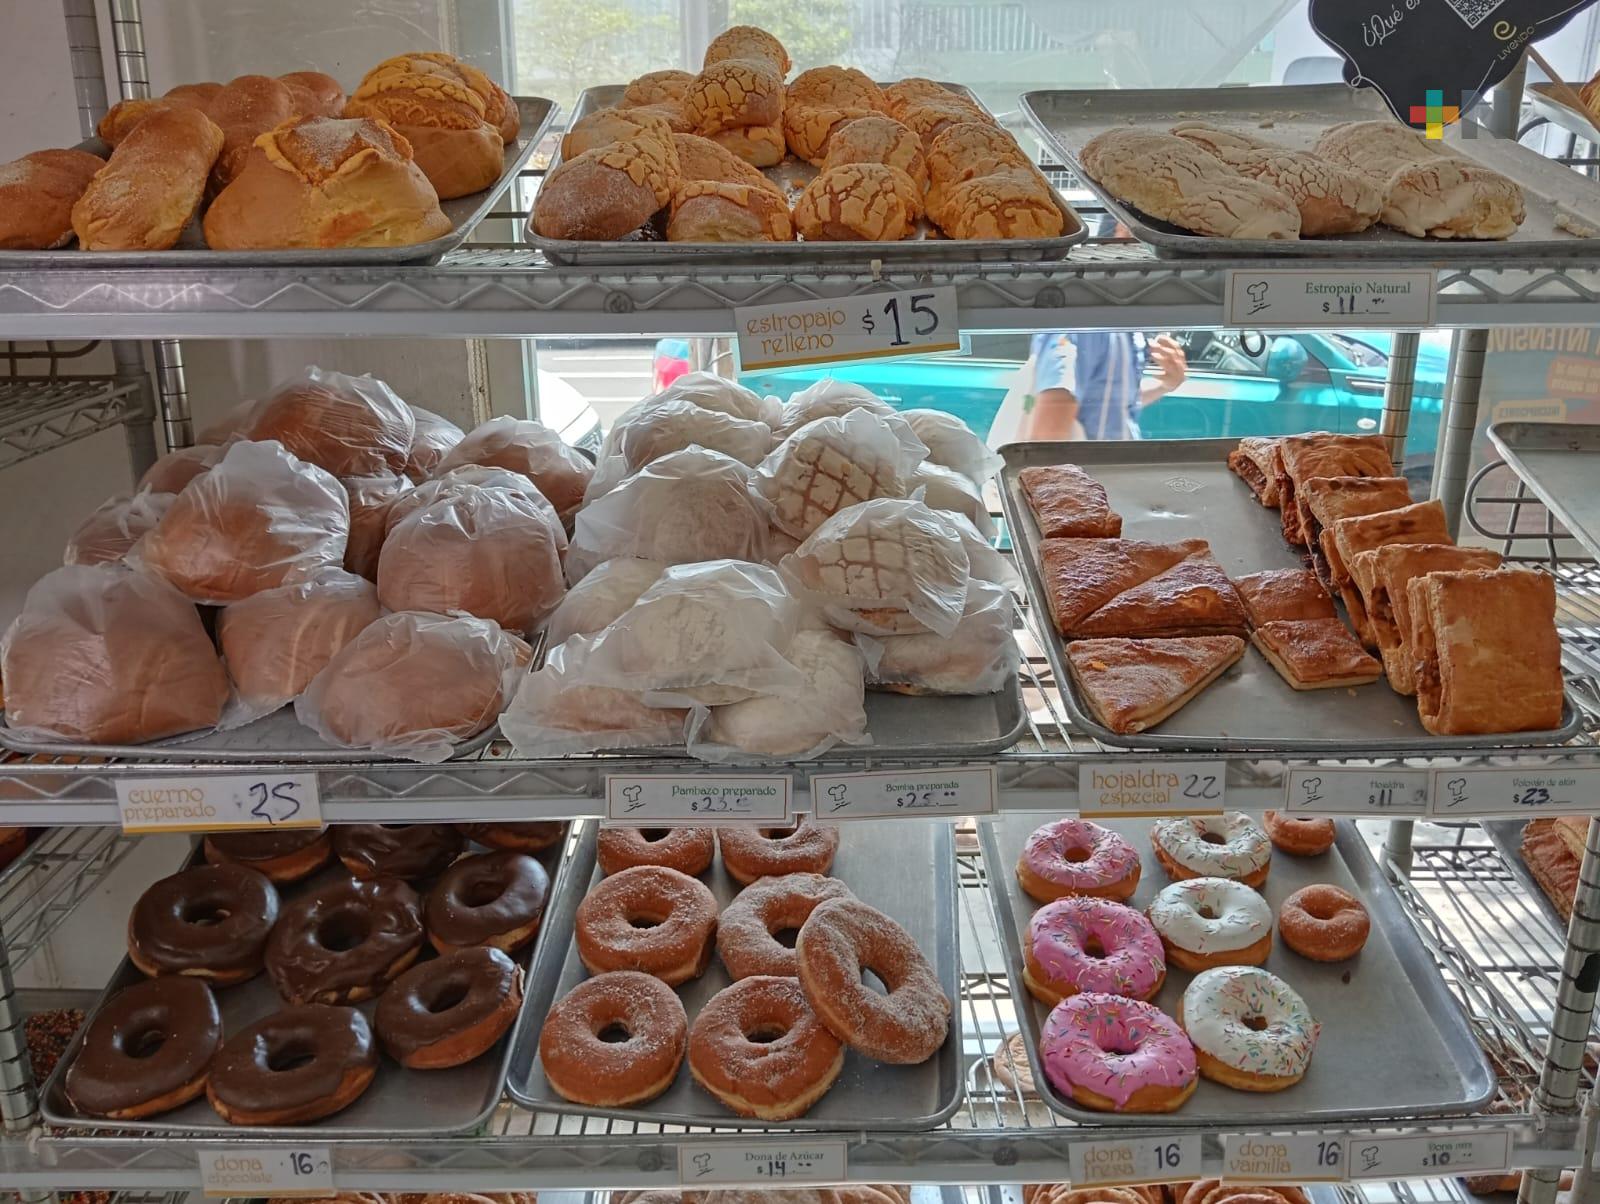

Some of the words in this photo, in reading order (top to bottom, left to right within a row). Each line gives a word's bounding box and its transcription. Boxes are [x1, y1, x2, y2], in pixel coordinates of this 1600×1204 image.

[1305, 282, 1362, 296] Estropajo
[1366, 281, 1411, 294] Natural
[746, 307, 847, 336] estropajo
[761, 333, 834, 355] relleno
[1092, 768, 1180, 791] hojaldra
[1183, 774, 1221, 799] 22
[128, 788, 204, 804] cuerno
[672, 785, 719, 797] Pambazo
[722, 785, 777, 798] preparado
[1100, 787, 1170, 807] especial
[124, 804, 216, 822] preparado
[745, 1152, 773, 1161] Dona
[775, 1152, 787, 1161] de
[790, 1152, 824, 1161] Azúcar
[1084, 1146, 1133, 1162] dona
[1154, 1143, 1180, 1169] 16
[1240, 1140, 1288, 1157] dona
[1317, 1141, 1341, 1166] 16
[214, 1153, 263, 1171] dona
[290, 1152, 314, 1175] 16
[1230, 1159, 1291, 1173] vainilla
